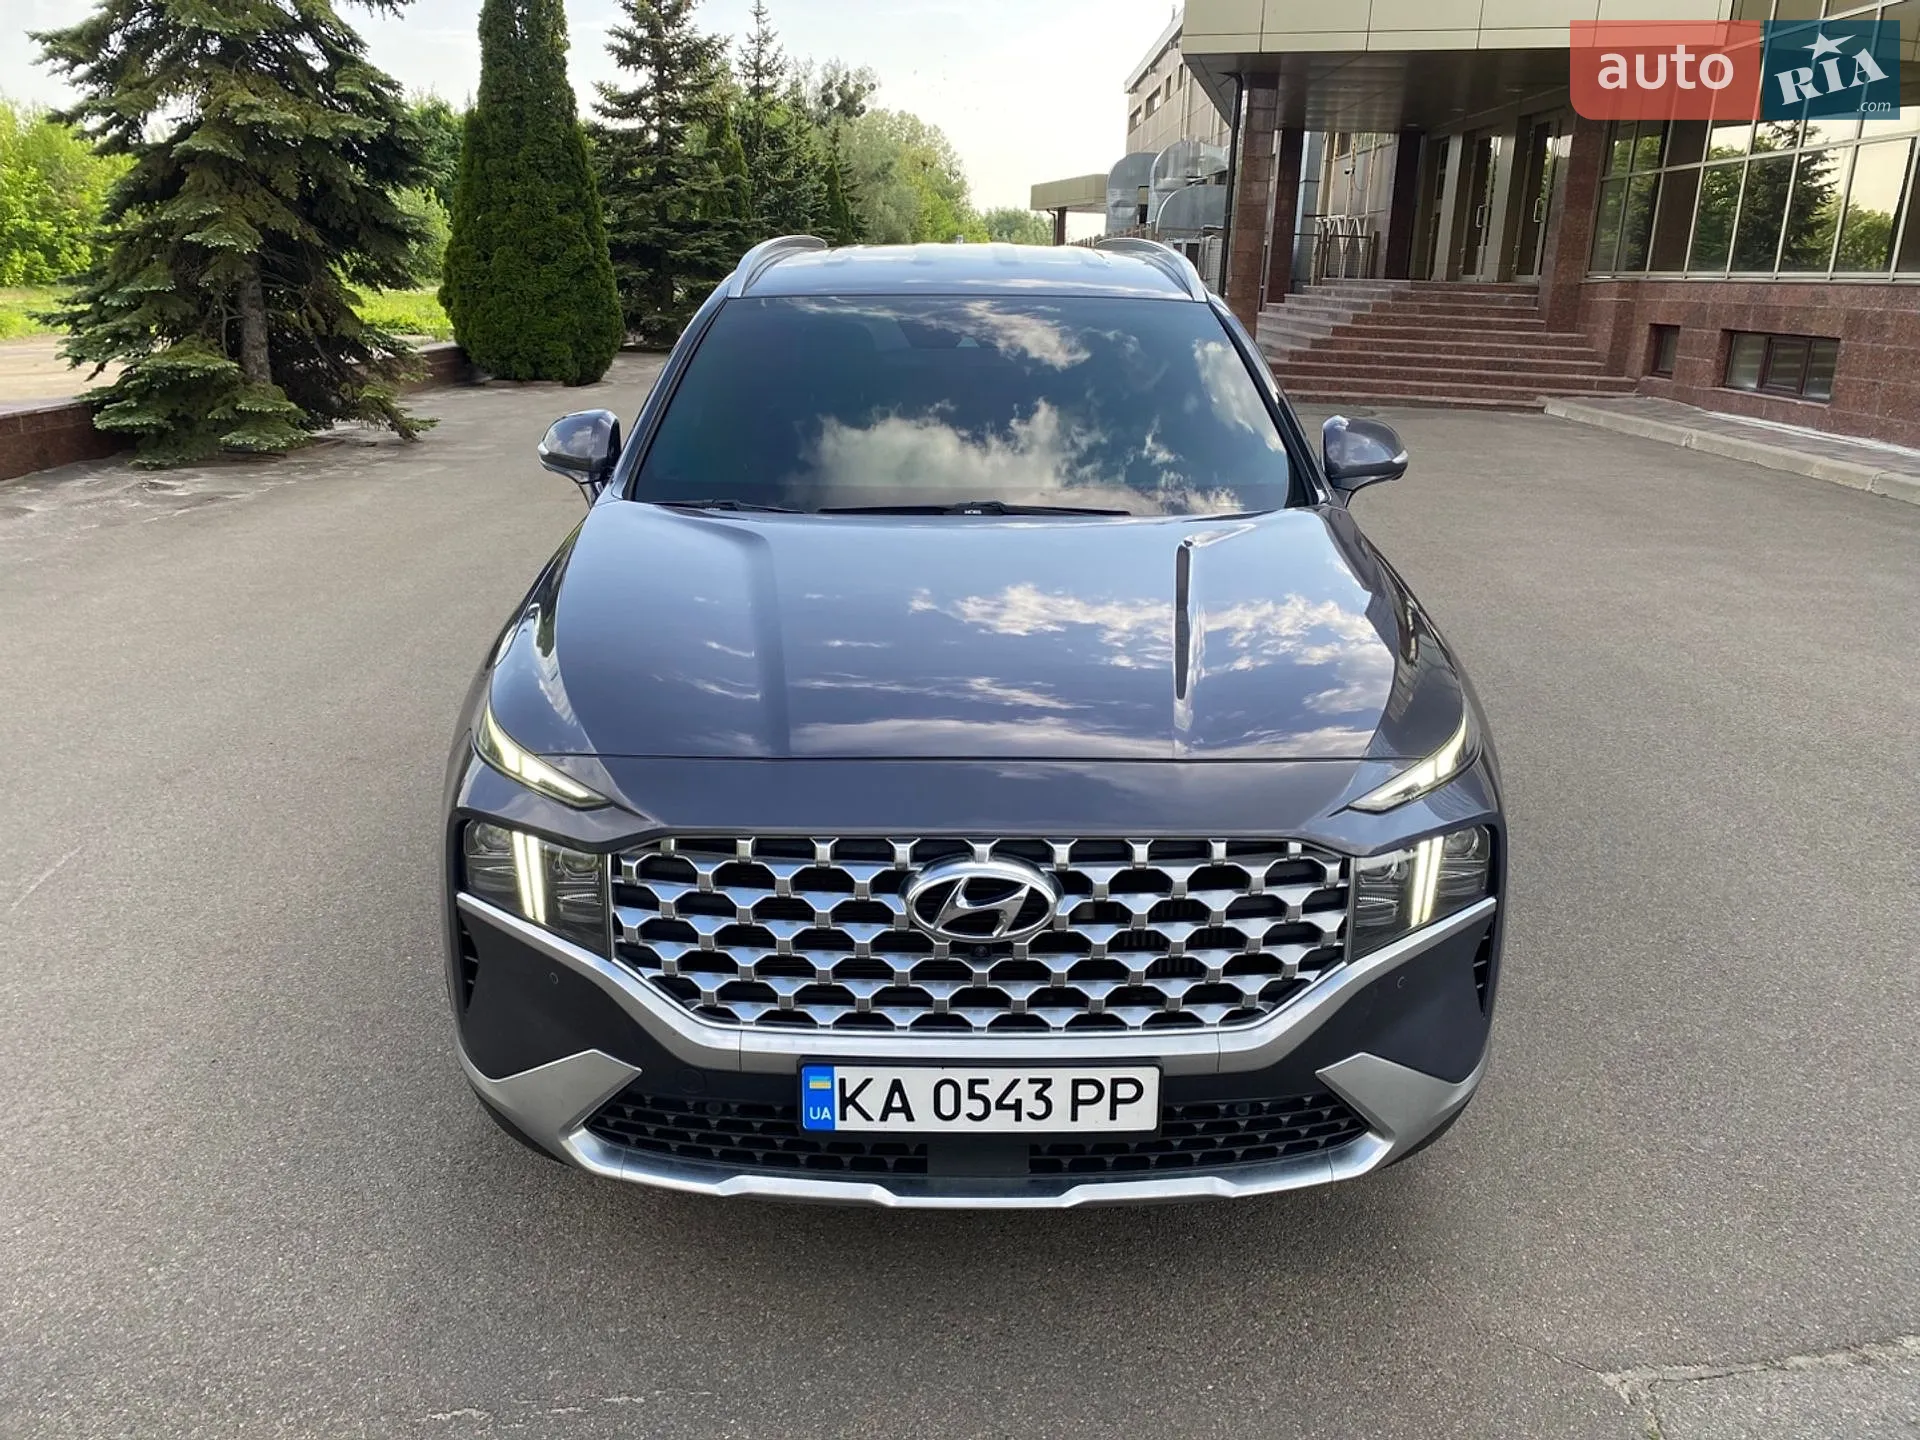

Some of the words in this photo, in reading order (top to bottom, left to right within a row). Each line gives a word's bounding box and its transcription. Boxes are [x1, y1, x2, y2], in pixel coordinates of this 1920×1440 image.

[809, 1107, 832, 1121] UA
[838, 1077, 914, 1122] KA
[933, 1078, 1053, 1122] 0543
[1070, 1077, 1144, 1122] PP
